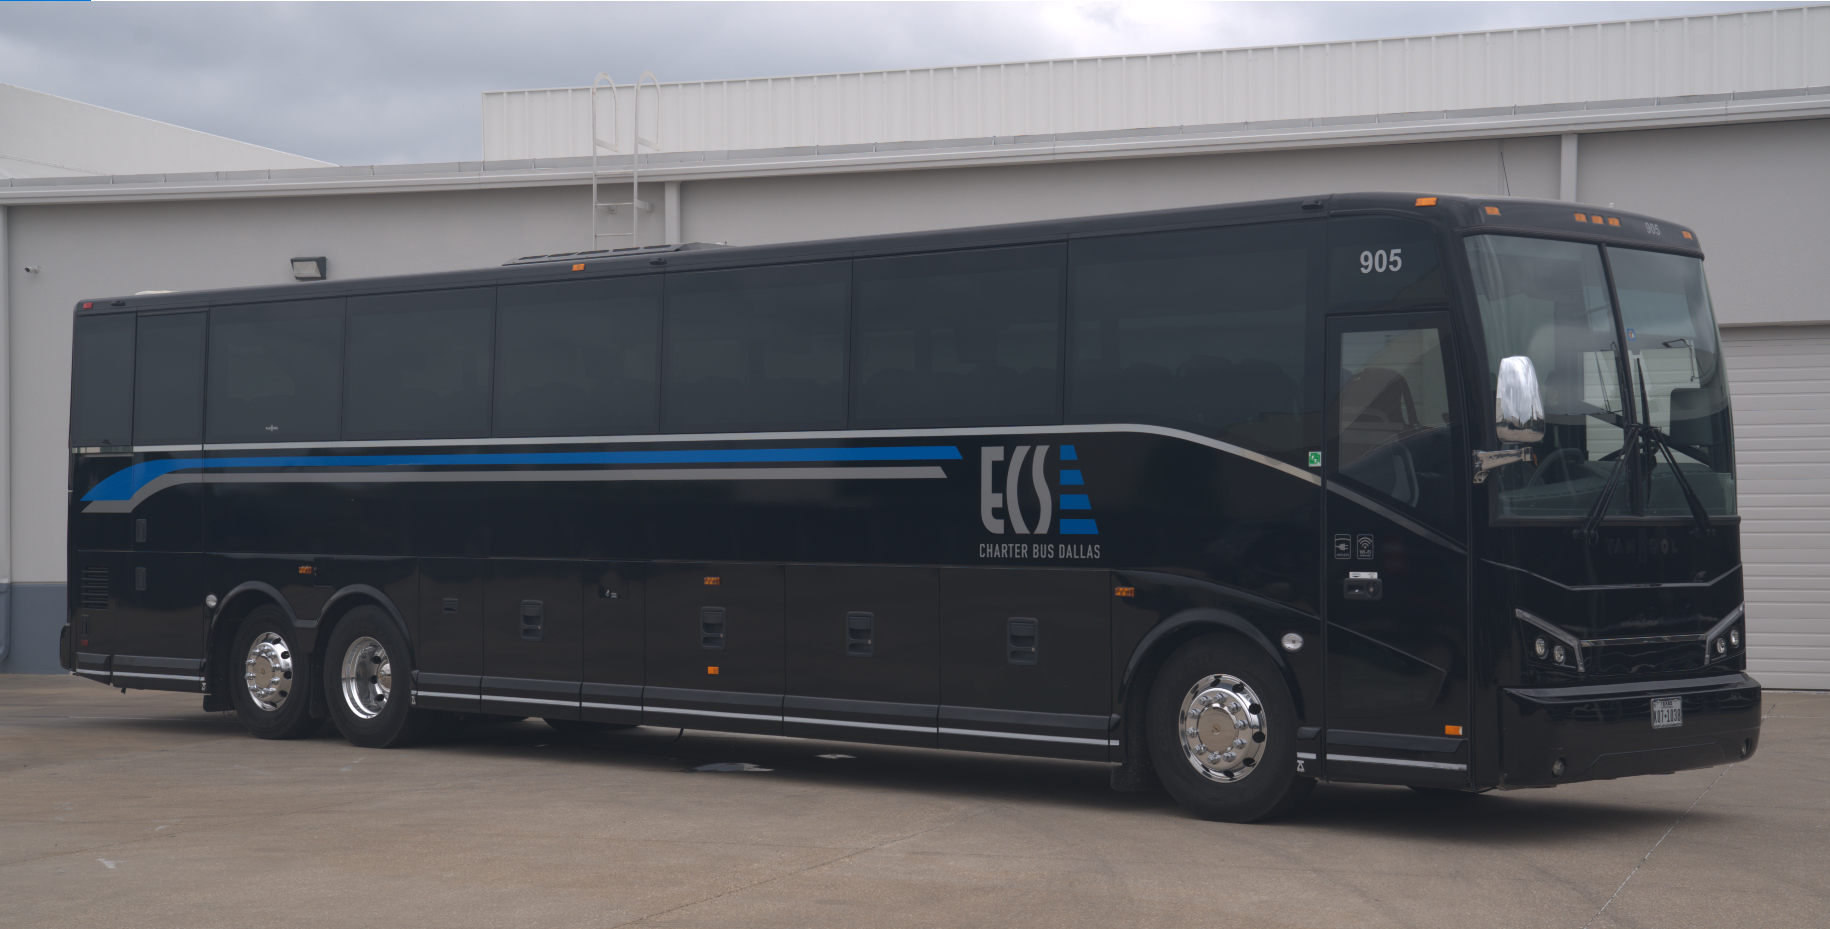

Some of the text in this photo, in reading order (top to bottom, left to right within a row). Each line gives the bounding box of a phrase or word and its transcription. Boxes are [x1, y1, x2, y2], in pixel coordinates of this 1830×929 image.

[1645, 222, 1660, 235] 905
[1360, 249, 1402, 273] 905
[981, 445, 1052, 534] ECS
[979, 543, 1100, 559] CHARTER BUS DALLAS
